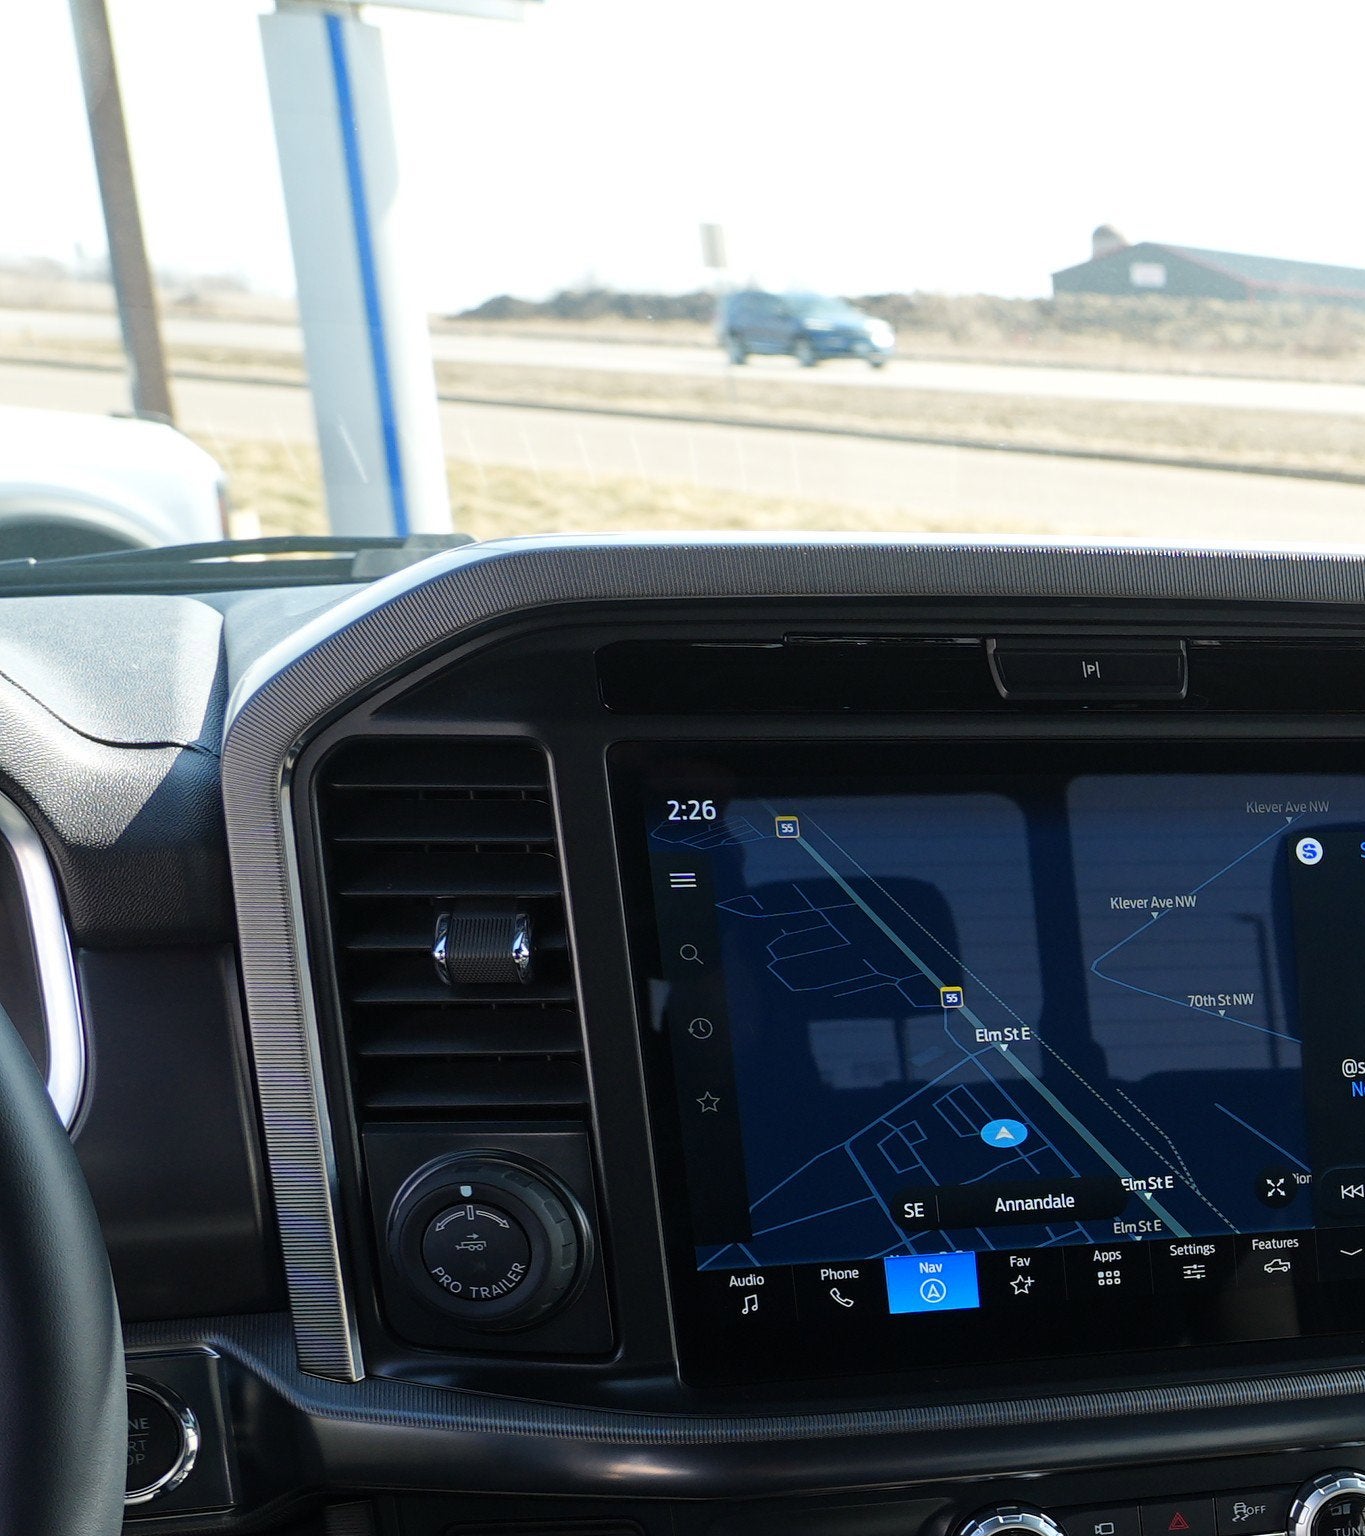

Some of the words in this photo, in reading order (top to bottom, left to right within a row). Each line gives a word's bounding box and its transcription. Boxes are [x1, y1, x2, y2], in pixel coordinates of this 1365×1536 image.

[667, 800, 717, 821] 2:26
[1246, 801, 1284, 814] Klever
[1286, 801, 1307, 814] Ave
[1309, 800, 1330, 813] NW
[781, 823, 794, 834] 55
[1110, 896, 1149, 910] Klever
[1150, 896, 1174, 909] Ave
[1175, 895, 1197, 908] NW
[946, 993, 958, 1003] 55
[1187, 995, 1217, 1008] 70th
[1218, 995, 1232, 1007] St
[1232, 994, 1254, 1006] NW
[975, 1029, 1003, 1043] Elm
[1004, 1028, 1020, 1042] St
[1021, 1027, 1031, 1040] E
[1121, 1178, 1147, 1192] Elm
[1148, 1177, 1164, 1190] St
[1164, 1175, 1174, 1189] E
[903, 1202, 925, 1218] SE
[994, 1193, 1075, 1213] Annandale
[1113, 1221, 1137, 1235] Elm
[1138, 1220, 1153, 1233] St
[1153, 1219, 1162, 1232] E
[1169, 1242, 1216, 1257] Settings
[1252, 1237, 1299, 1251] Features
[1009, 1255, 1031, 1267] Fav
[1093, 1249, 1122, 1263] Apps
[820, 1267, 860, 1281] Phone
[919, 1261, 943, 1274] Nav
[431, 1266, 462, 1293] PRO
[469, 1261, 527, 1298] TRAILER
[728, 1274, 765, 1287] Audio
[1246, 1504, 1266, 1516] OFF
